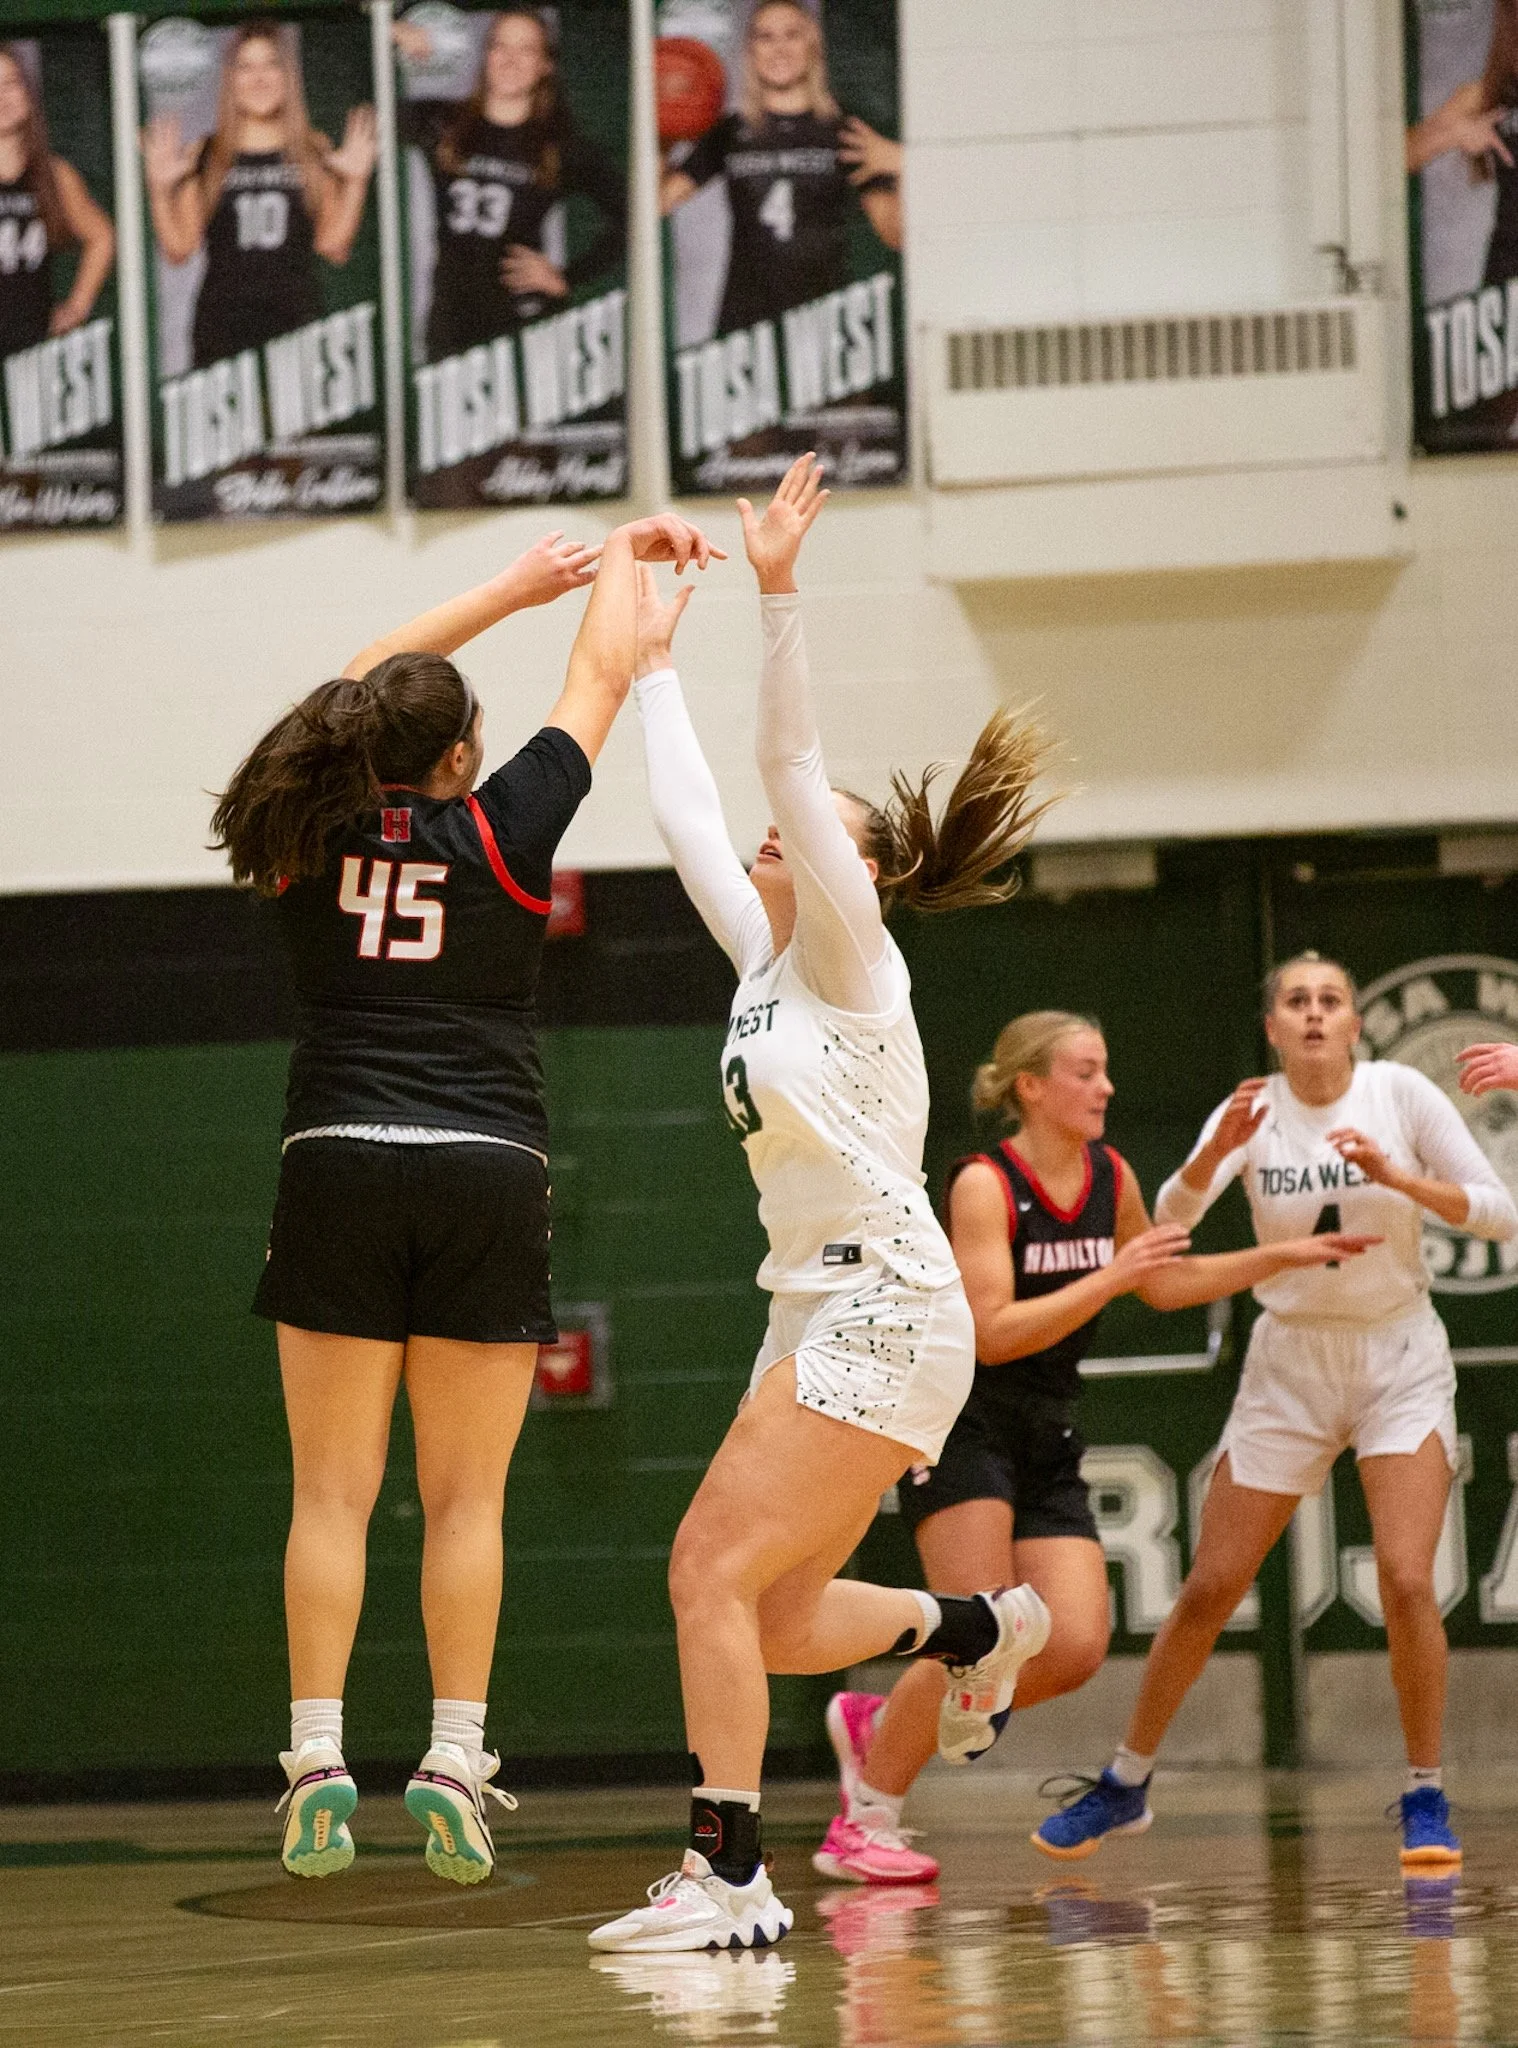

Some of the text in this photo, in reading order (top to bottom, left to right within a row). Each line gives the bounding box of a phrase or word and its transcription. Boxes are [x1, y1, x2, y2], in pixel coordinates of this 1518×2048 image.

[0, 218, 47, 274] 44
[235, 190, 289, 251] 10
[447, 178, 513, 238] 33
[758, 179, 796, 241] 4
[4, 317, 113, 457] WEST
[160, 302, 375, 488] TOSA WEST
[416, 289, 627, 474] TOSA WEST
[675, 273, 894, 460] TOSA WEST
[337, 854, 450, 961] 45
[722, 1054, 763, 1141] 3
[1259, 1160, 1376, 1197] TOSA WE
